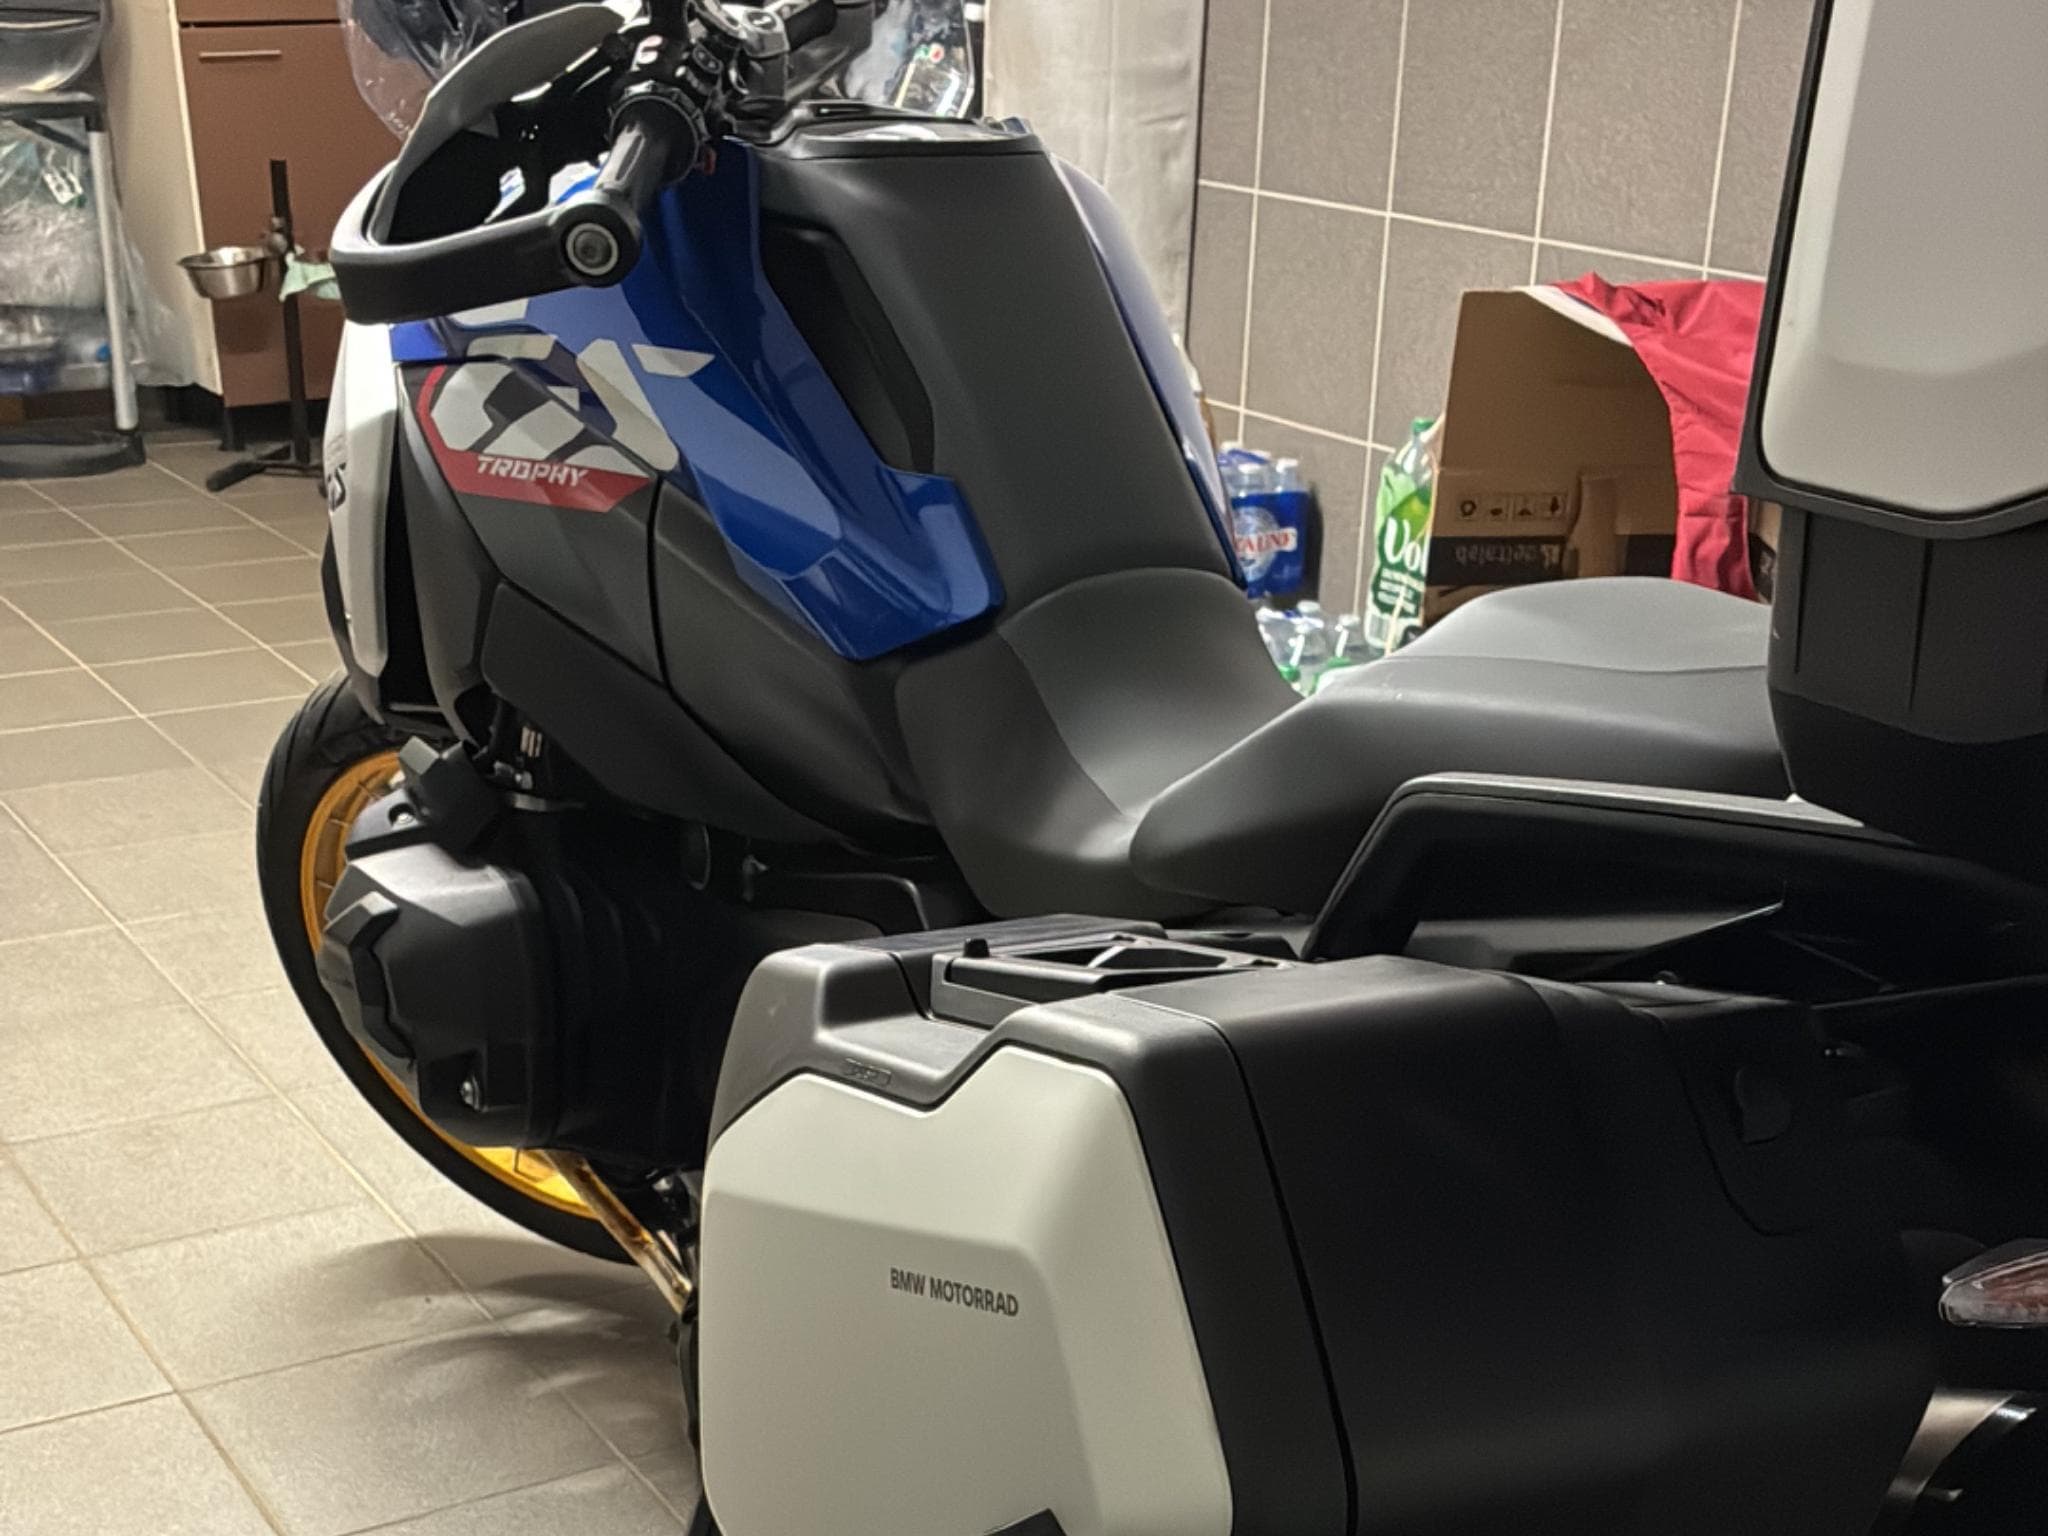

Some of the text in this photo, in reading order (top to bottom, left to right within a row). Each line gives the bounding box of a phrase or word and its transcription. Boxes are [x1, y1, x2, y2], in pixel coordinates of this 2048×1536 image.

[477, 455, 589, 487] TROPHY
[890, 1267, 1020, 1317] BMW MOTORRAD
